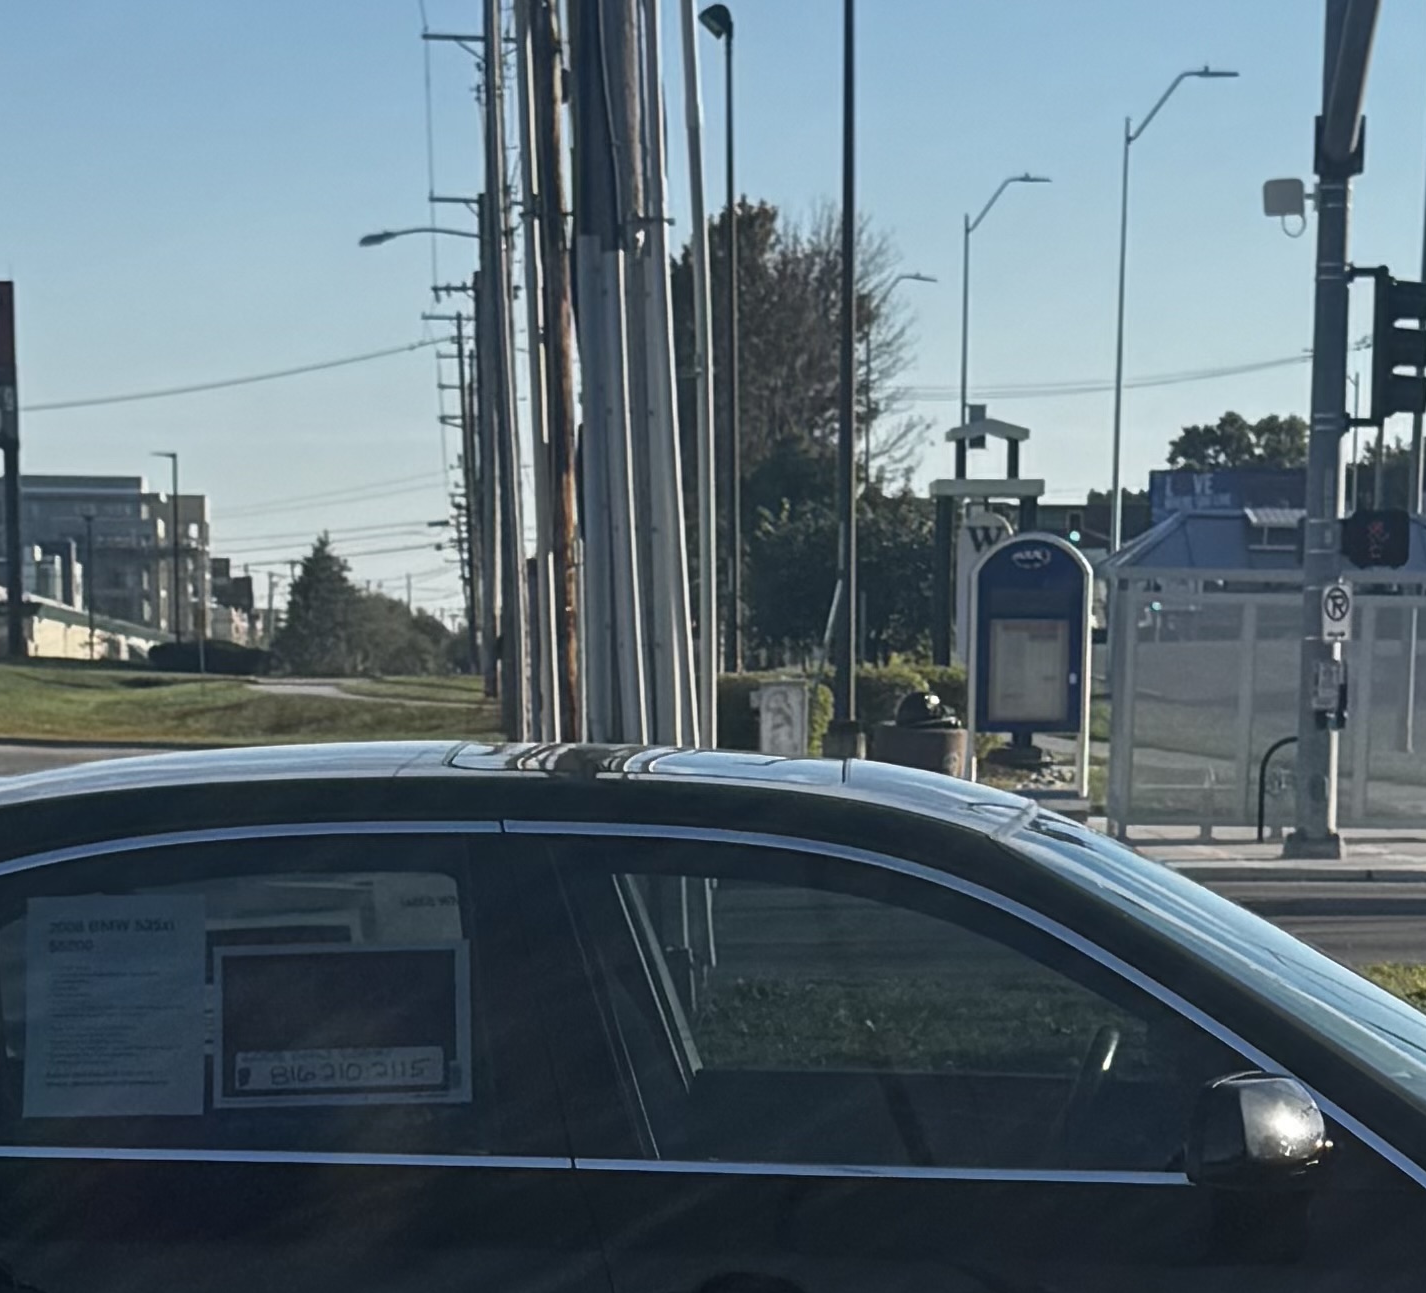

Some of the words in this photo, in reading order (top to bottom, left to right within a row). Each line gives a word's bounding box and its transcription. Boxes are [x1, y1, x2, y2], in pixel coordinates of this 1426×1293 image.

[1165, 473, 1214, 497] LVE
[967, 526, 1002, 552] W
[88, 919, 130, 933] BMW
[270, 1065, 316, 1085] 816
[370, 1058, 430, 1079] 2115
